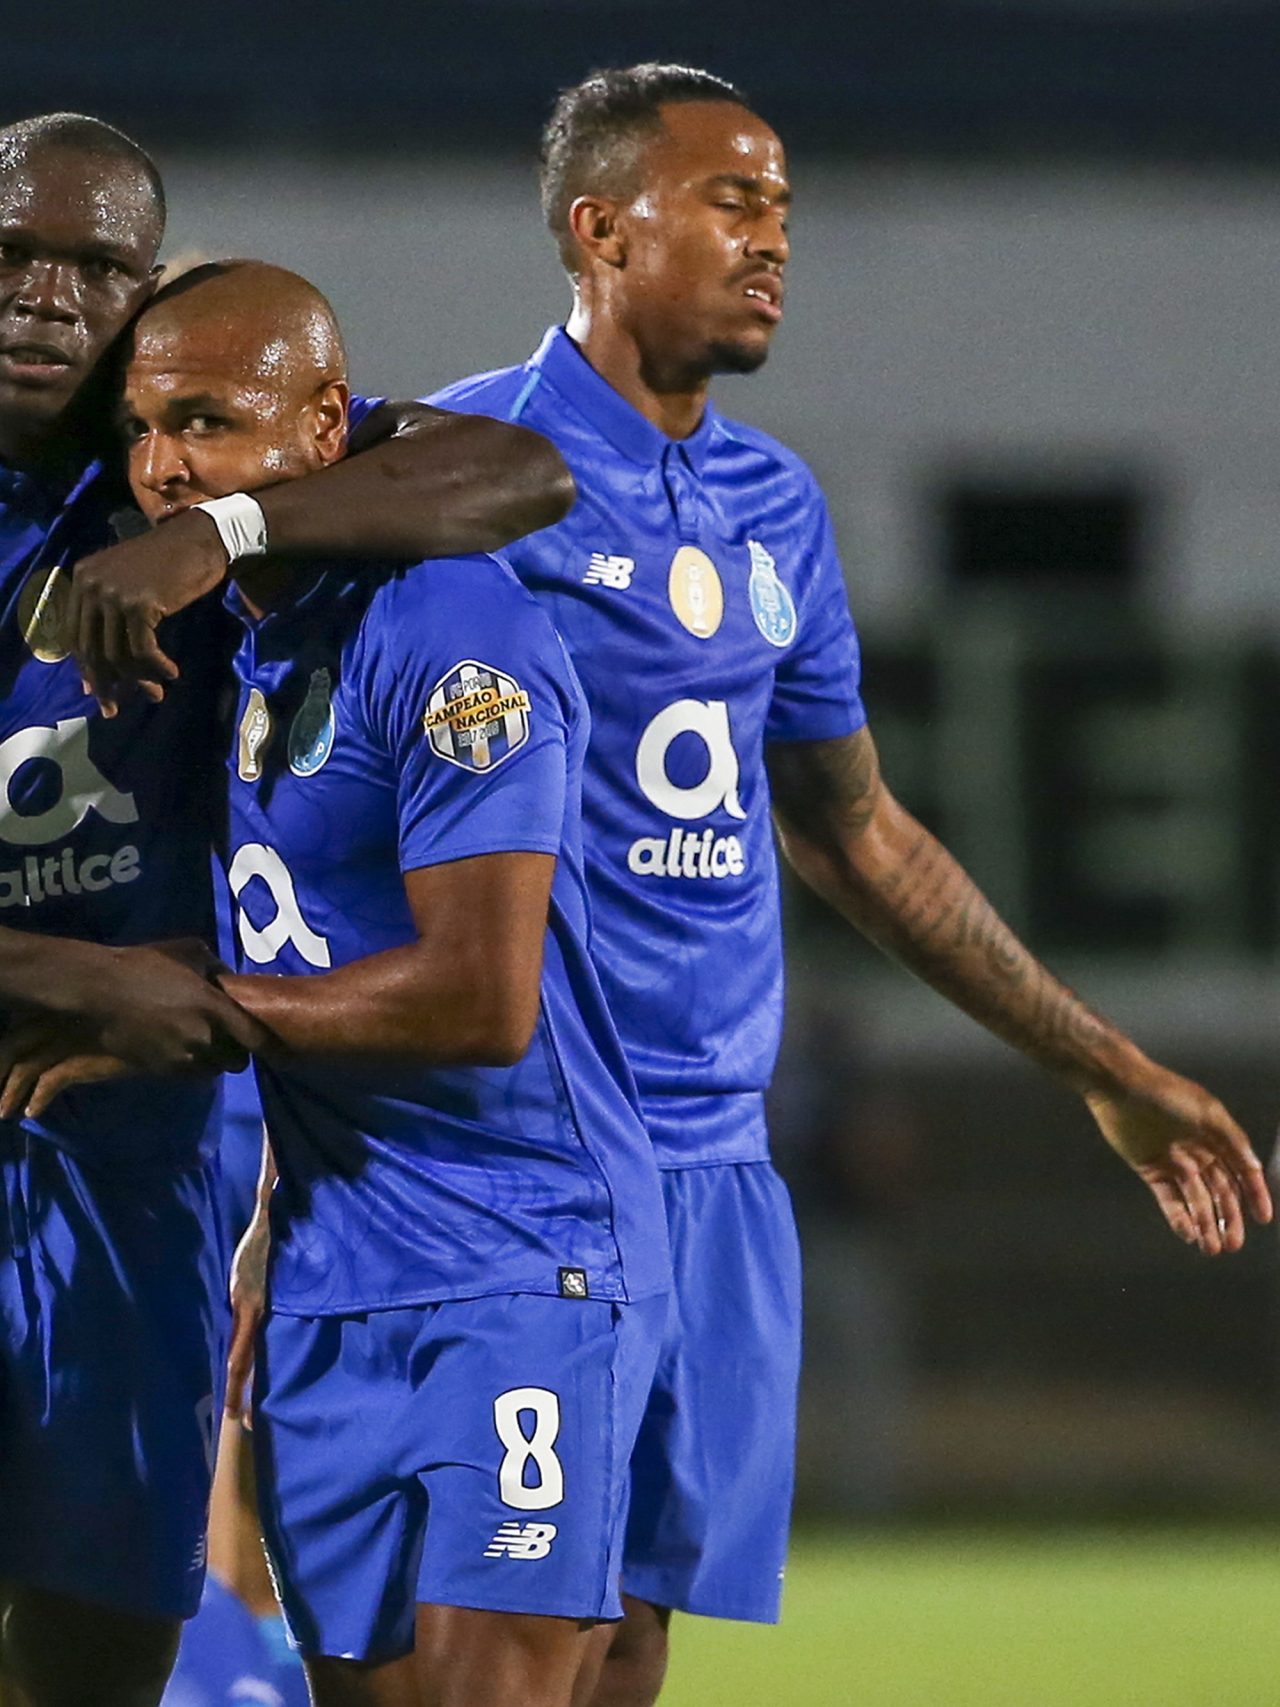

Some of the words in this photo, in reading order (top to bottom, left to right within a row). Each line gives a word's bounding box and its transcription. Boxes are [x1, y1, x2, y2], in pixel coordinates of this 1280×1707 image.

[456, 695, 526, 729] NACIONAL
[628, 828, 745, 878] altice
[494, 1386, 565, 1511] 8
